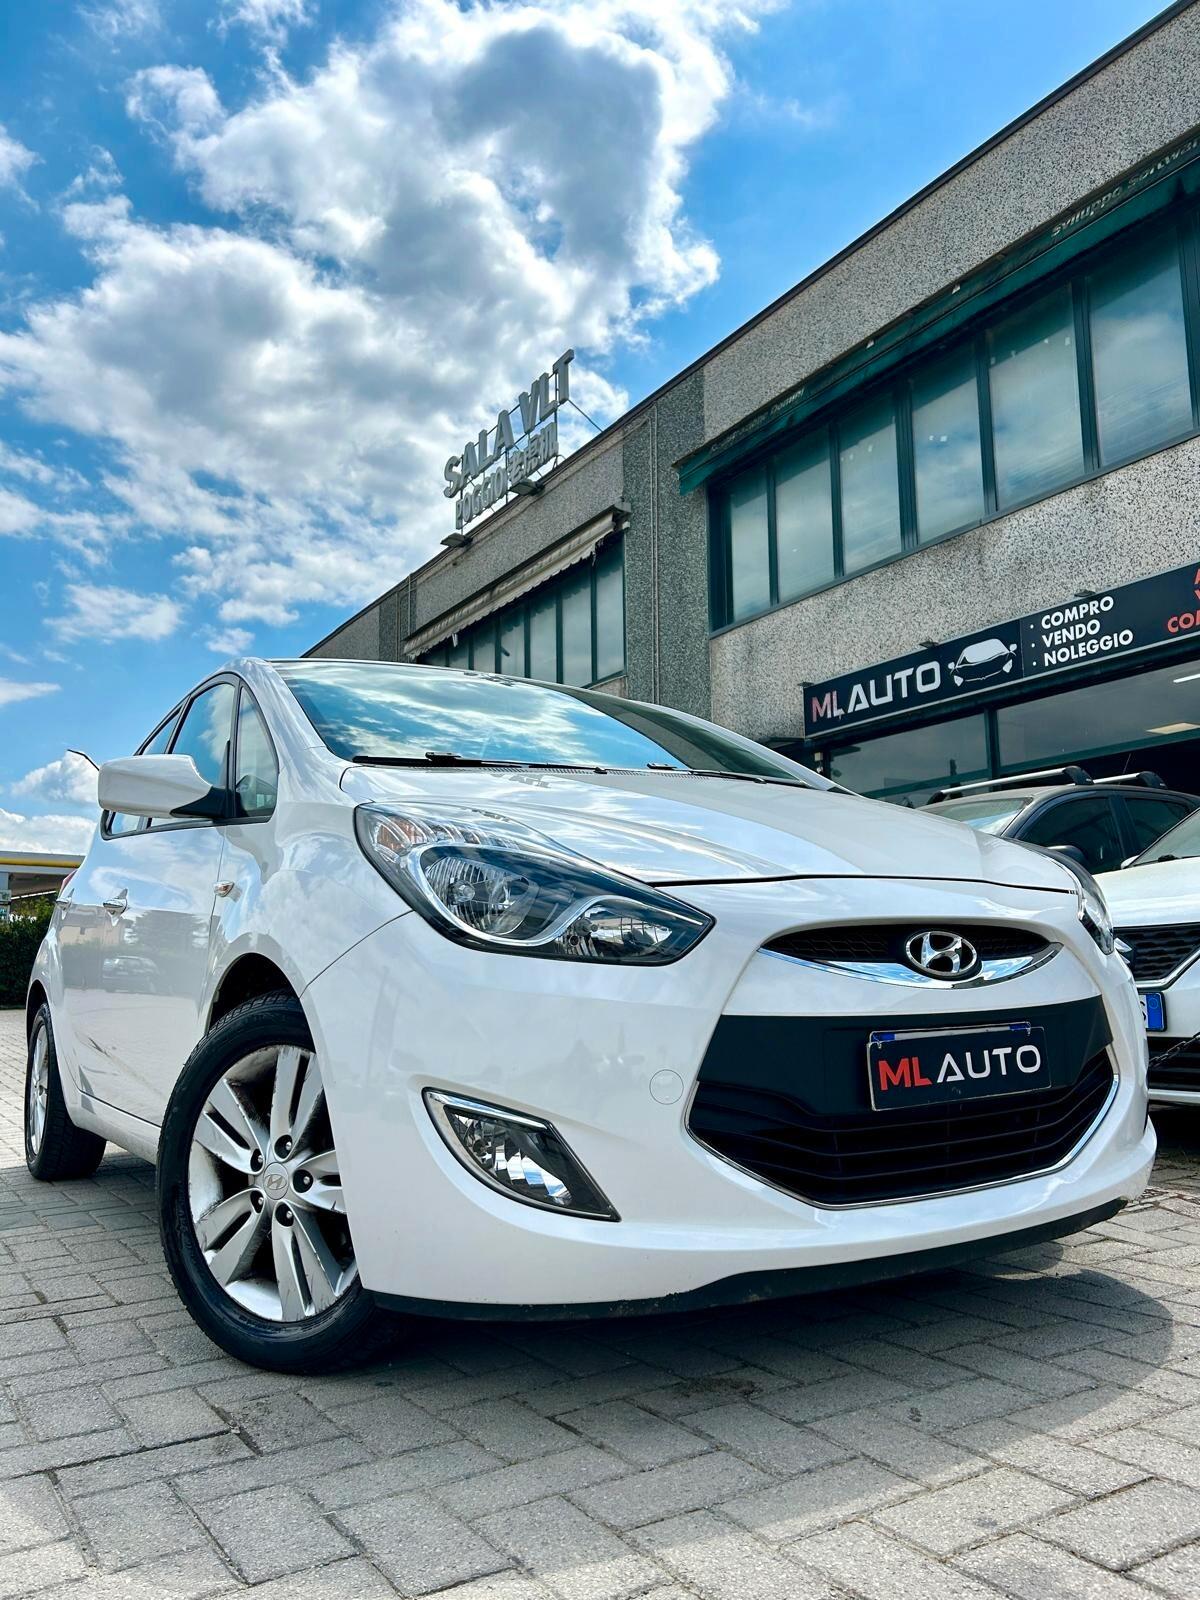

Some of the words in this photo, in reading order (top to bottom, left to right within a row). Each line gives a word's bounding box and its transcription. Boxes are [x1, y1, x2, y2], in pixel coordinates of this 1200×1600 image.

[443, 409, 514, 498] SALA
[518, 348, 575, 434] VLT
[455, 466, 508, 530] POGGIO
[1041, 595, 1114, 630] COMPRO
[1042, 619, 1101, 648] VENDO
[1043, 629, 1134, 667] NOLEGGIO
